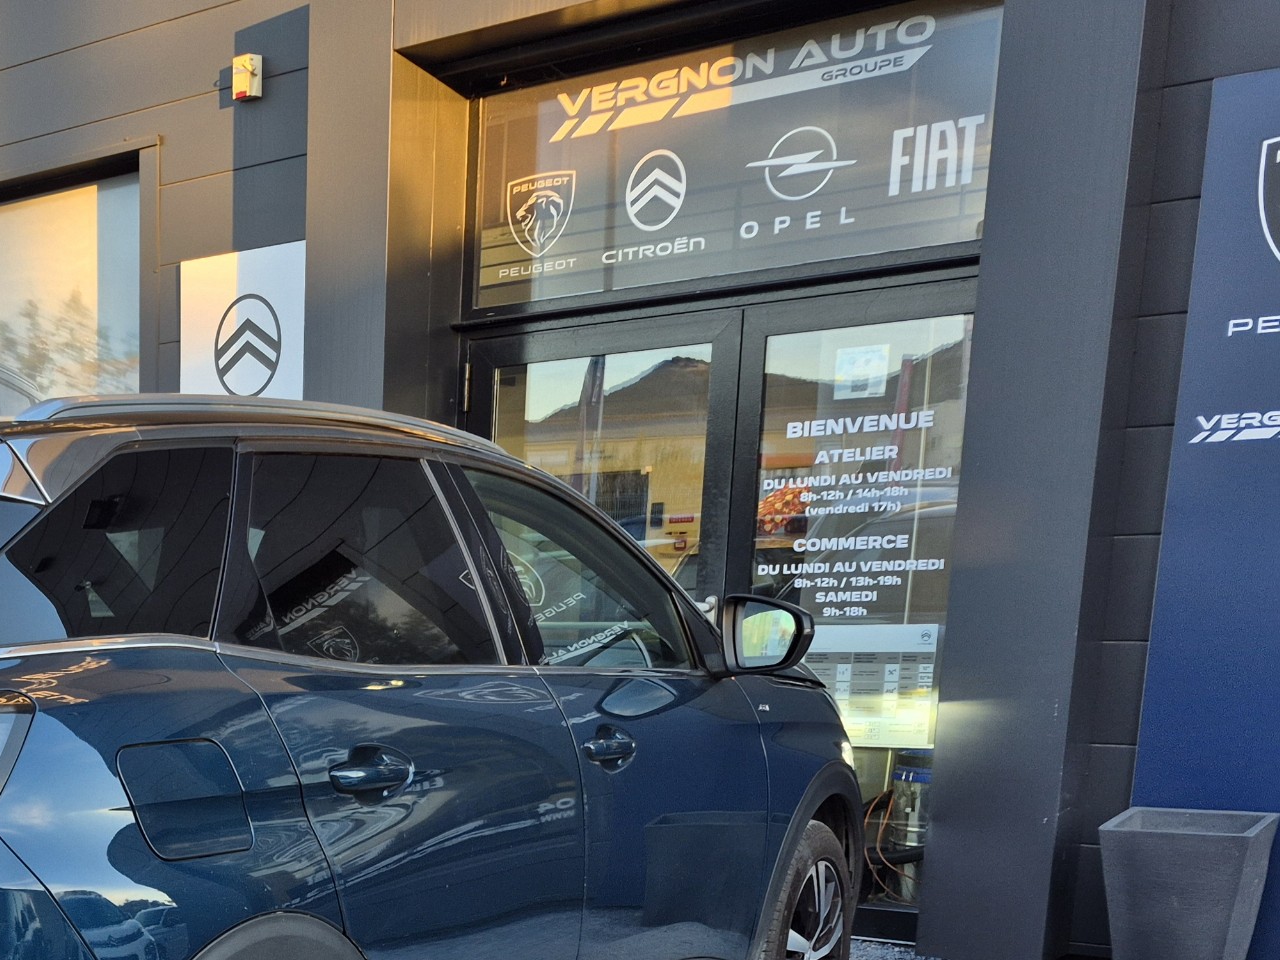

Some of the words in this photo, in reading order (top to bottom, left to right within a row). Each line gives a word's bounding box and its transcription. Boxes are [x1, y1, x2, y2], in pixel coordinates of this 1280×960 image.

[557, 48, 775, 116] VERGNON
[789, 15, 936, 70] AUTO
[821, 55, 905, 82] GROUPE
[888, 114, 985, 196] FIAT
[513, 177, 570, 194] PEUGEOT
[740, 207, 855, 239] OPEL
[499, 258, 577, 278] PEUGEOT
[786, 410, 935, 439] BIENVENUE
[814, 445, 899, 465] ATELIER
[763, 478, 785, 491] DU
[788, 475, 836, 489] LUNDI
[839, 473, 863, 486] AU
[866, 467, 952, 483] VENDREDI
[799, 489, 844, 502] 8h-12h
[805, 503, 869, 518] (vendredi
[871, 500, 902, 513] 17h)
[792, 534, 909, 553] COMMERCE
[757, 564, 780, 576] DU
[782, 561, 830, 575] LUNDI
[832, 560, 857, 573] AU
[860, 558, 945, 572] VENDREDI
[793, 576, 838, 588] 8h-12h
[849, 575, 902, 587] 13h-19h
[815, 591, 878, 603] SAMEDI
[822, 606, 868, 617] 9h-18h
